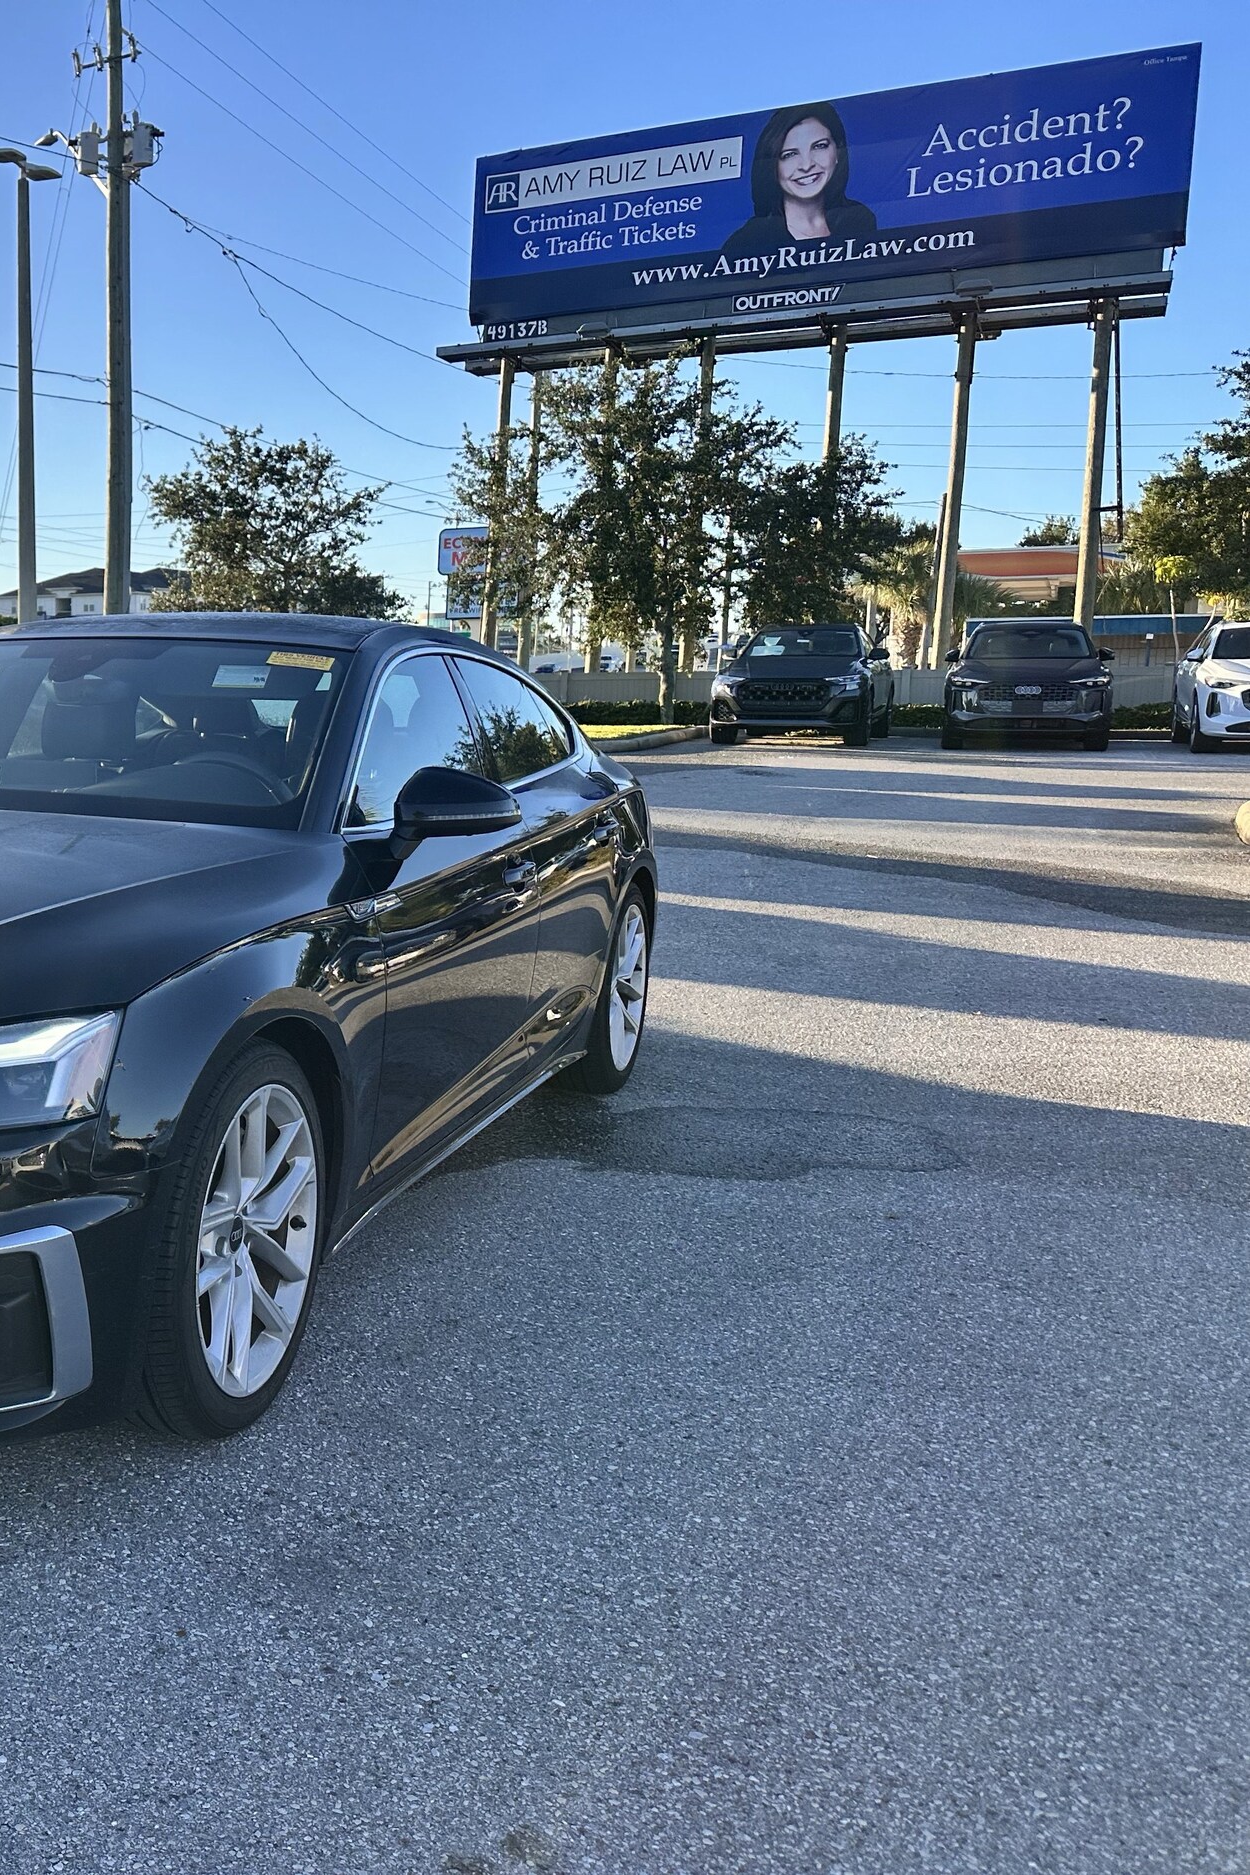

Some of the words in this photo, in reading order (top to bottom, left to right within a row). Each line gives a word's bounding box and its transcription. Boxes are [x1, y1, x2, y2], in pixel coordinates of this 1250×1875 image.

[921, 96, 1132, 157] Accident?
[524, 170, 581, 198] AMY
[589, 159, 647, 188] RUIZ
[657, 149, 715, 178] LAW
[720, 156, 738, 169] PL
[906, 136, 1145, 198] Lesionado?
[513, 203, 606, 235] Criminal
[613, 196, 703, 222] Defense
[521, 240, 540, 260] &
[546, 230, 613, 257] Traffic
[619, 221, 697, 247] Tickets
[632, 228, 976, 286] www.AmyRuizLaw.com
[487, 319, 548, 340] 49137B
